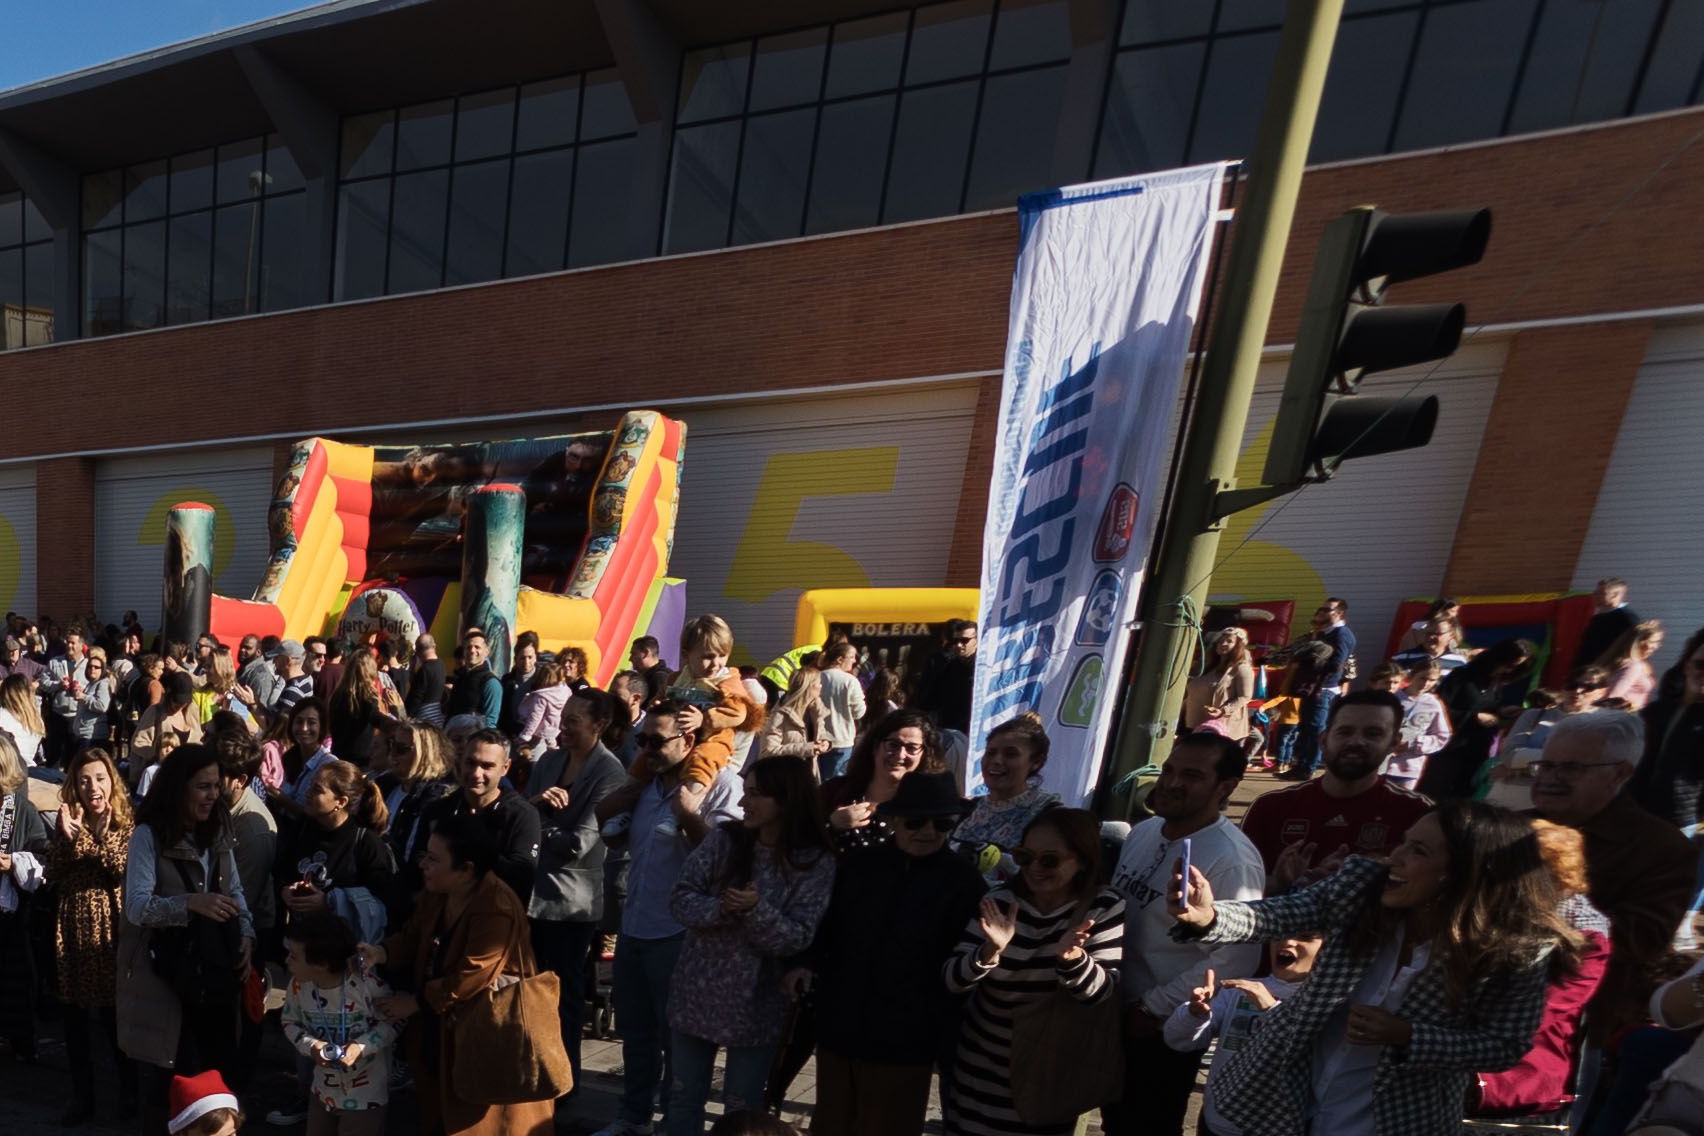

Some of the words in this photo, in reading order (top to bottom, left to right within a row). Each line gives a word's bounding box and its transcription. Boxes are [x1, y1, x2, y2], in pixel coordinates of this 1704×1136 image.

[722, 447, 900, 665] 5
[378, 617, 415, 634] Potter
[852, 623, 930, 636] BOLERA
